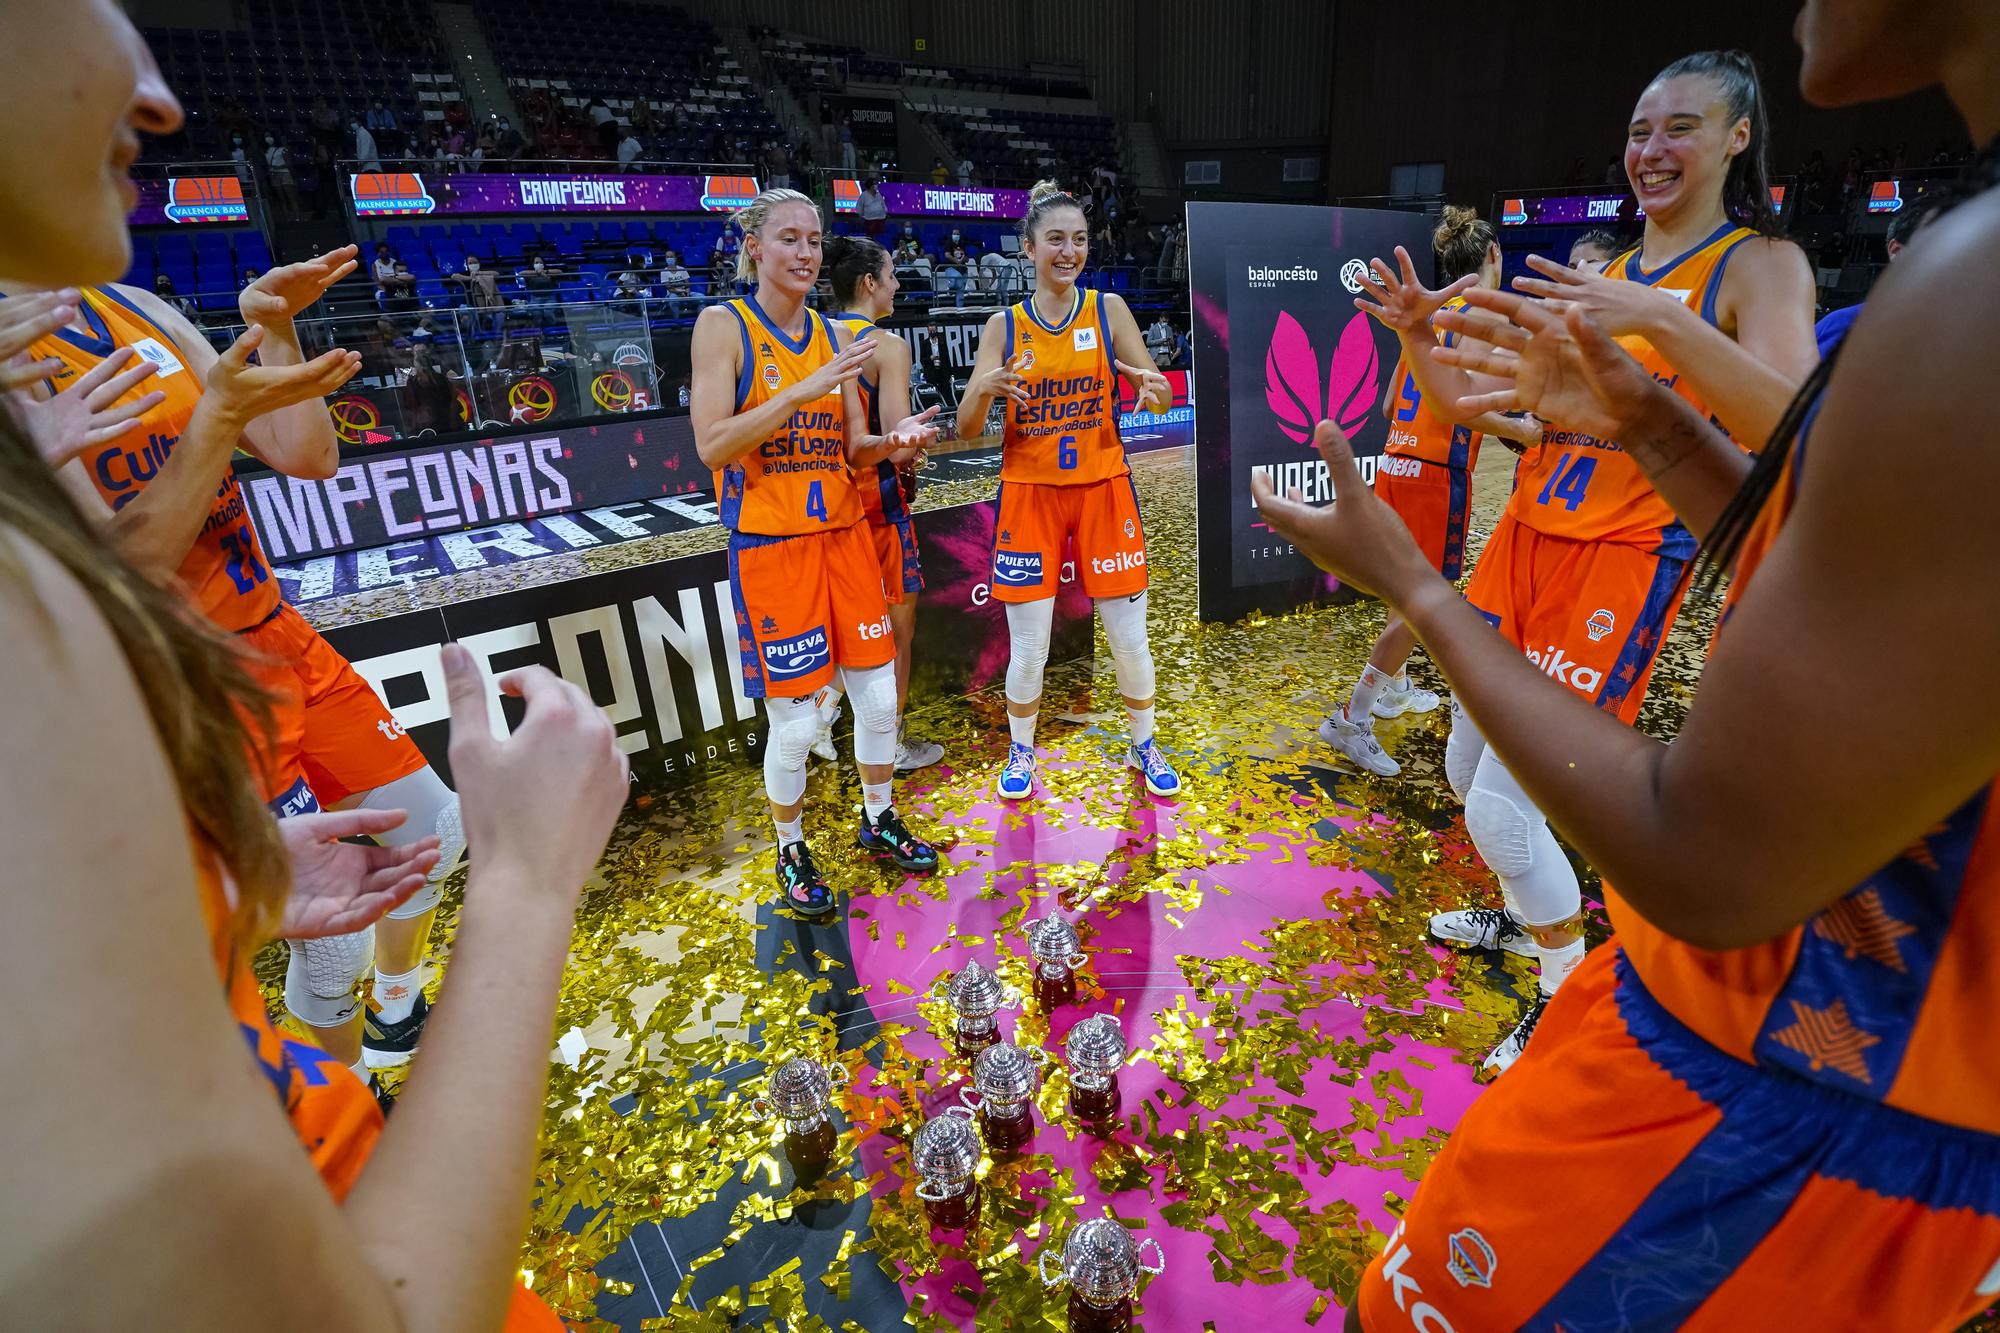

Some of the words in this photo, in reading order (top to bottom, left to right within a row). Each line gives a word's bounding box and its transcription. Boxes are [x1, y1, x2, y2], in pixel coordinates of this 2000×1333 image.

[852, 109, 893, 123] SUPERCOPA
[355, 200, 395, 209] VALENCIA
[397, 200, 427, 208] BASKET
[519, 181, 626, 205] CAMPEONAS
[706, 198, 738, 207] VALENCIA
[924, 189, 995, 212] CAMPEONAS
[1870, 200, 1896, 208] BASKET
[174, 206, 220, 216] VALENCIA
[1016, 376, 1093, 400] Cultura
[1154, 409, 1191, 424] BASKET
[96, 432, 183, 491] Cult
[1058, 436, 1078, 470] 6
[1537, 453, 1598, 512] 14
[238, 437, 573, 558] MPEONAS
[806, 480, 828, 522] 4
[996, 553, 1041, 567] PULEVA
[1092, 550, 1146, 575] teika
[766, 632, 825, 658] PULEVA
